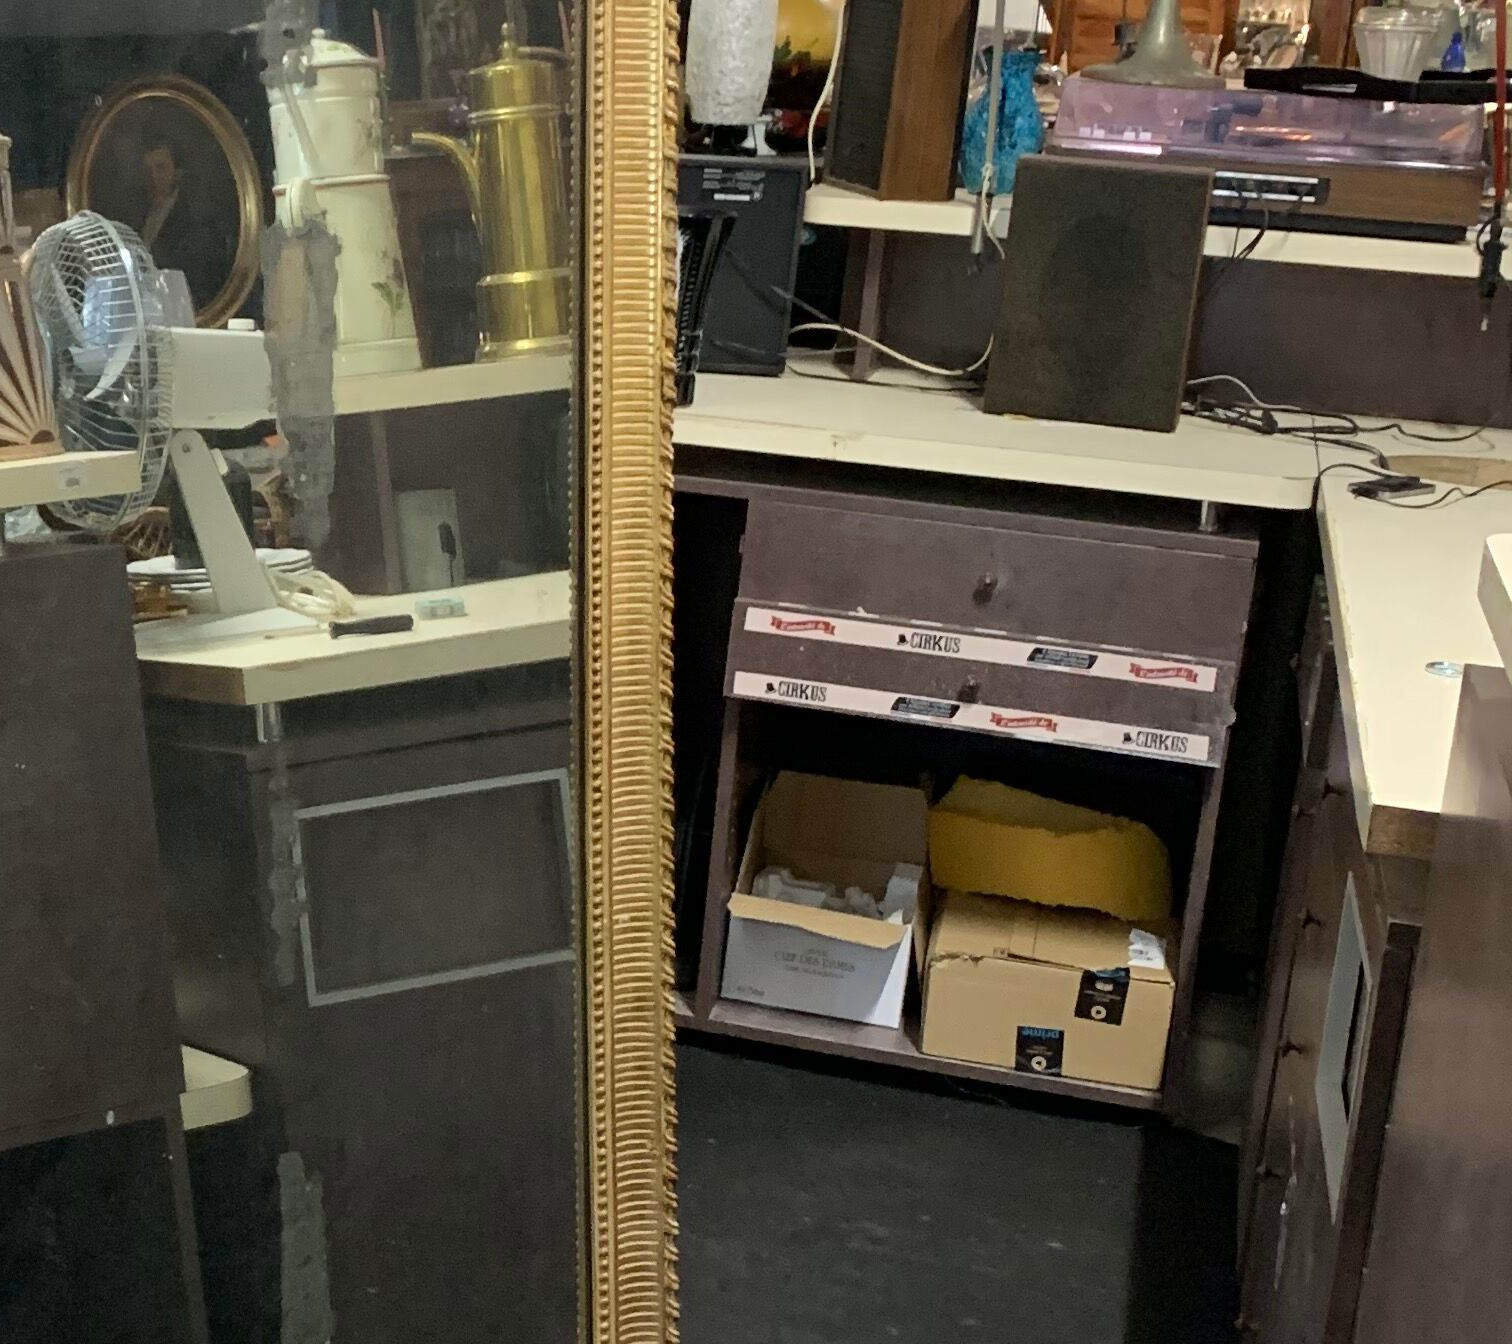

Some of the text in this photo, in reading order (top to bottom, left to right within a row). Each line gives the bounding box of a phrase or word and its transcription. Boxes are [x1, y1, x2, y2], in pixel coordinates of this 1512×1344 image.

[909, 631, 961, 654] CIRKUS
[778, 680, 828, 703] CIRKUS
[1136, 730, 1189, 754] CIRKUS
[1021, 1027, 1059, 1040] prime
